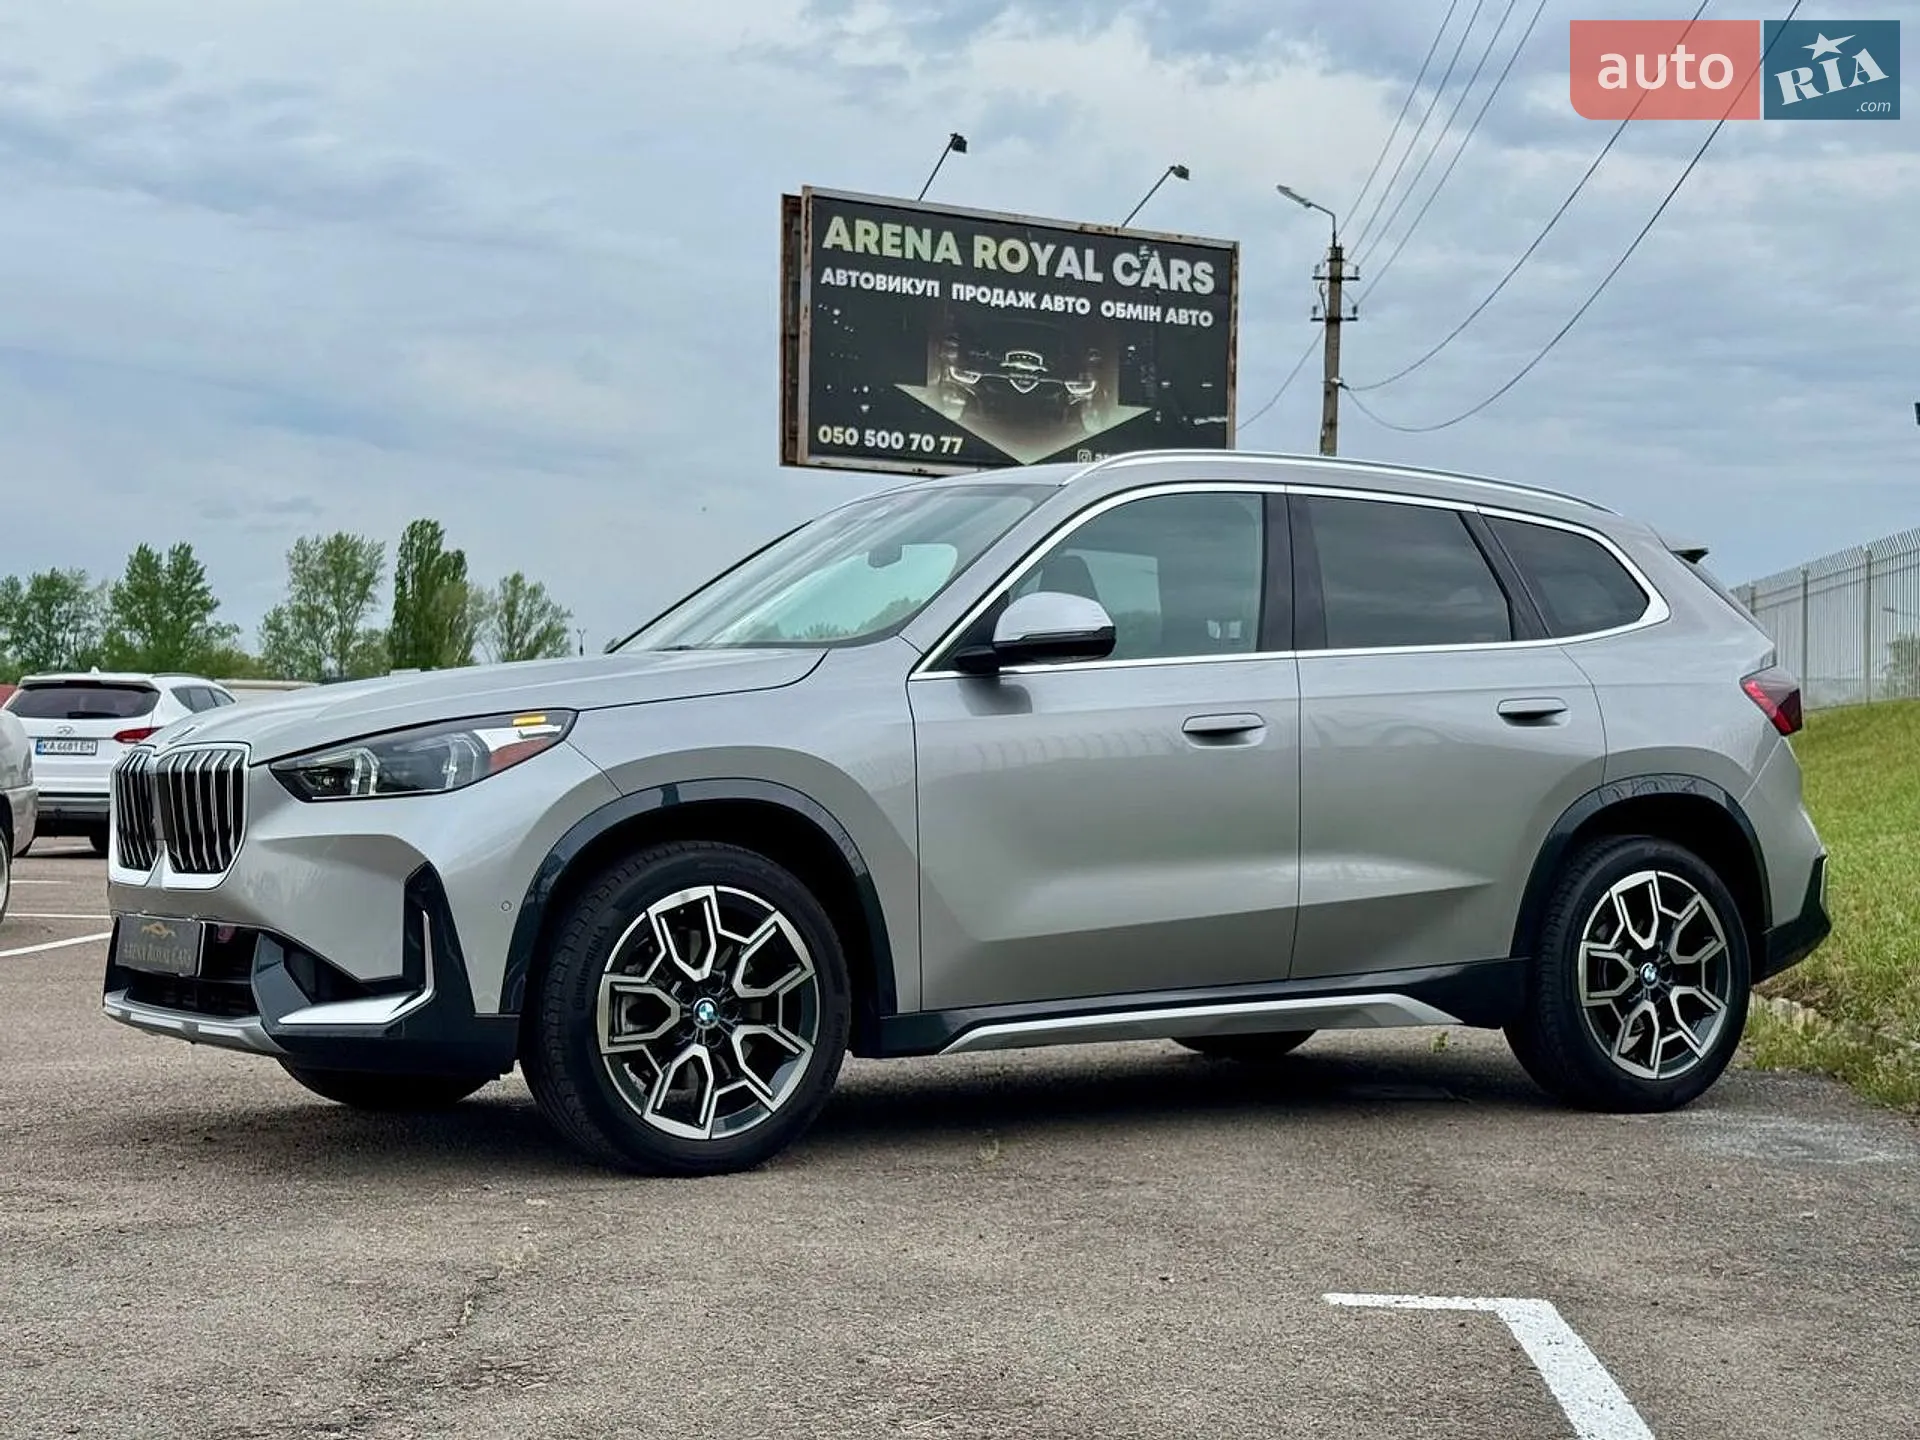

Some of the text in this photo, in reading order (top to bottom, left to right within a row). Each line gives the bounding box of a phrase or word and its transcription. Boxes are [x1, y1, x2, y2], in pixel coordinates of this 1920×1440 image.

[822, 216, 1215, 295] ARENA ROYAL CARS
[820, 267, 1214, 327] АВТОВИКУП ПРОДАЖ АВТО ОБМІН АВТО
[818, 425, 964, 455] 050 500 70 77
